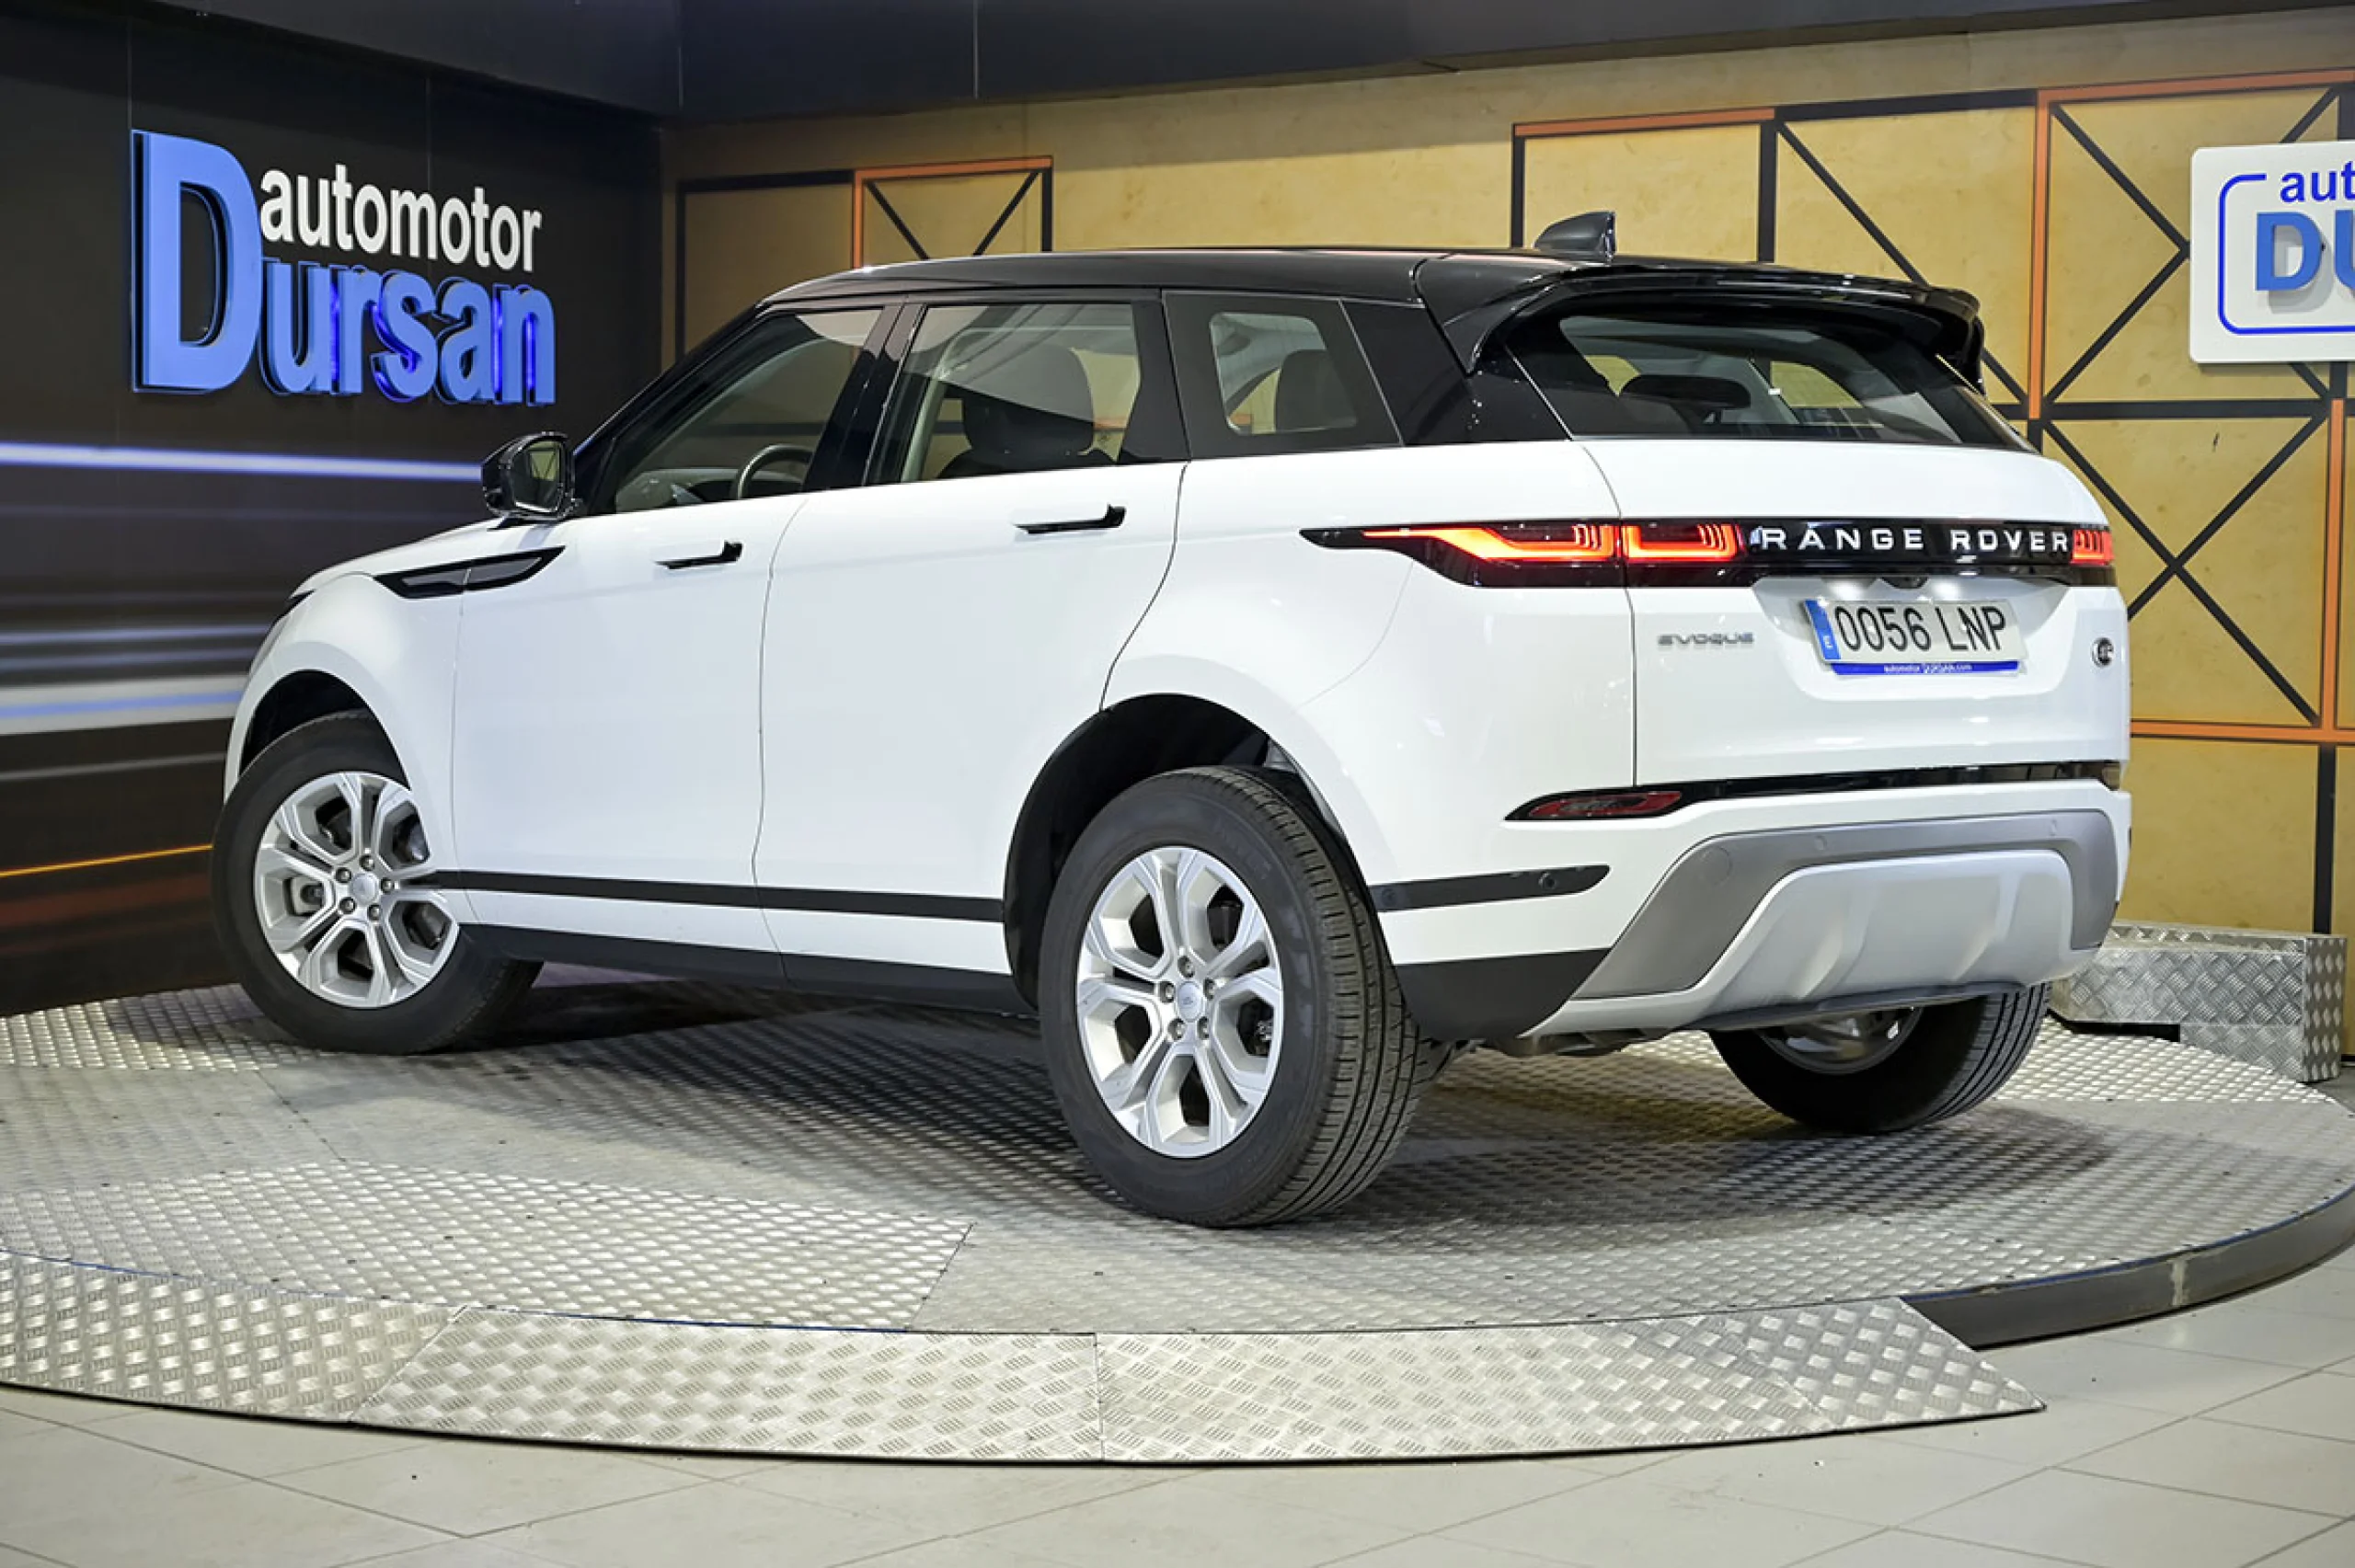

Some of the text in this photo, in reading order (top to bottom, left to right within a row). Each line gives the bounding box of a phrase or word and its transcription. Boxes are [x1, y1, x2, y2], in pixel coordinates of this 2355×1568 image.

[2280, 161, 2355, 202] aut
[260, 164, 543, 272] automotor
[132, 129, 556, 406] Dursan
[1761, 529, 2067, 551] RANGE ROVER
[1658, 632, 1754, 645] EVOQUE
[1834, 606, 1931, 651] 0056
[1935, 606, 2006, 651] LNP
